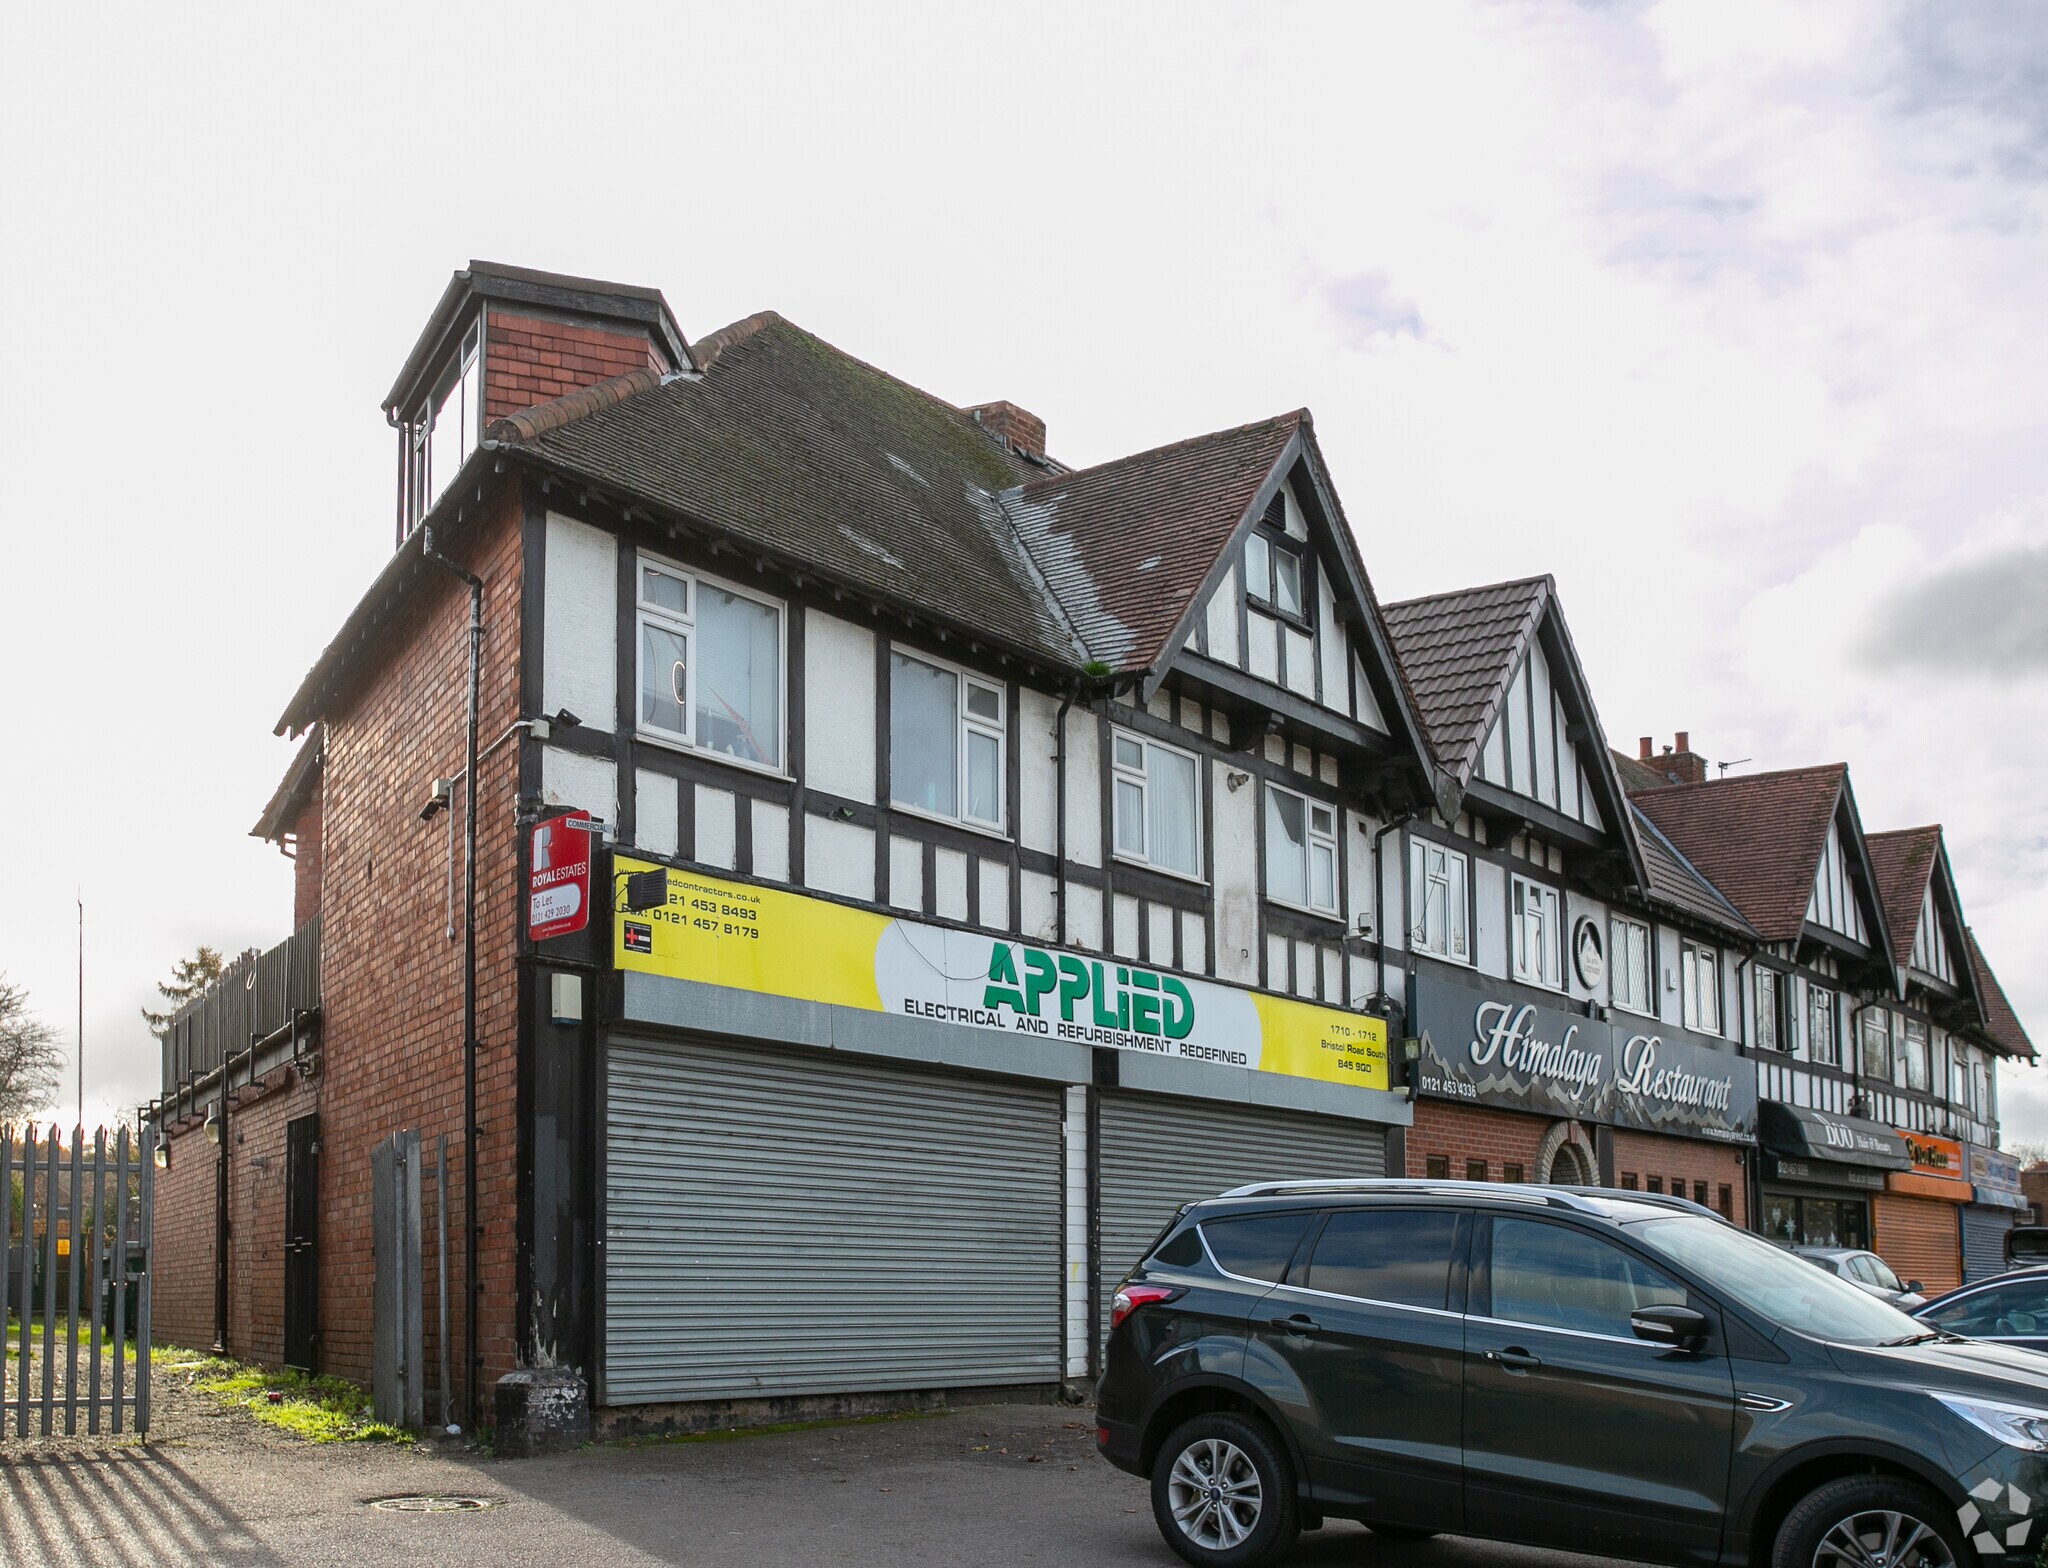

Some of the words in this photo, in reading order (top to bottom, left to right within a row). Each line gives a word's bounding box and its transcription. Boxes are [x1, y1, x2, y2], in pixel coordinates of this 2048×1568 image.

[567, 819, 608, 833] COMMERCIAL
[532, 898, 541, 910] To
[542, 896, 553, 907] Let
[691, 898, 717, 913] 453
[721, 905, 757, 921] 8493
[531, 912, 543, 924] 0121
[544, 910, 555, 919] 429
[556, 905, 571, 917] 2030
[653, 909, 688, 925] 0121
[693, 919, 719, 932] 457
[723, 924, 759, 939] 8179
[904, 998, 1006, 1028] ELECTRICAL
[1016, 1017, 1049, 1034] AND
[1057, 1023, 1172, 1053] REFURBISHMENT
[1179, 1043, 1247, 1065] REDEFINED
[1330, 1024, 1350, 1037] 1710
[1358, 1029, 1377, 1042] 1712
[1320, 1039, 1345, 1052] Bristol
[1347, 1044, 1365, 1056] Road
[1366, 1047, 1386, 1059] South
[1470, 1001, 1602, 1101] Himalaya
[1616, 1035, 1732, 1112] Restaurant
[1337, 1059, 1353, 1070] B45
[1421, 1076, 1441, 1092] 0121
[1442, 1080, 1457, 1095] 453
[1458, 1083, 1477, 1098] 4336
[1856, 1135, 1869, 1149] Hair
[1874, 1138, 1892, 1155] Beauty
